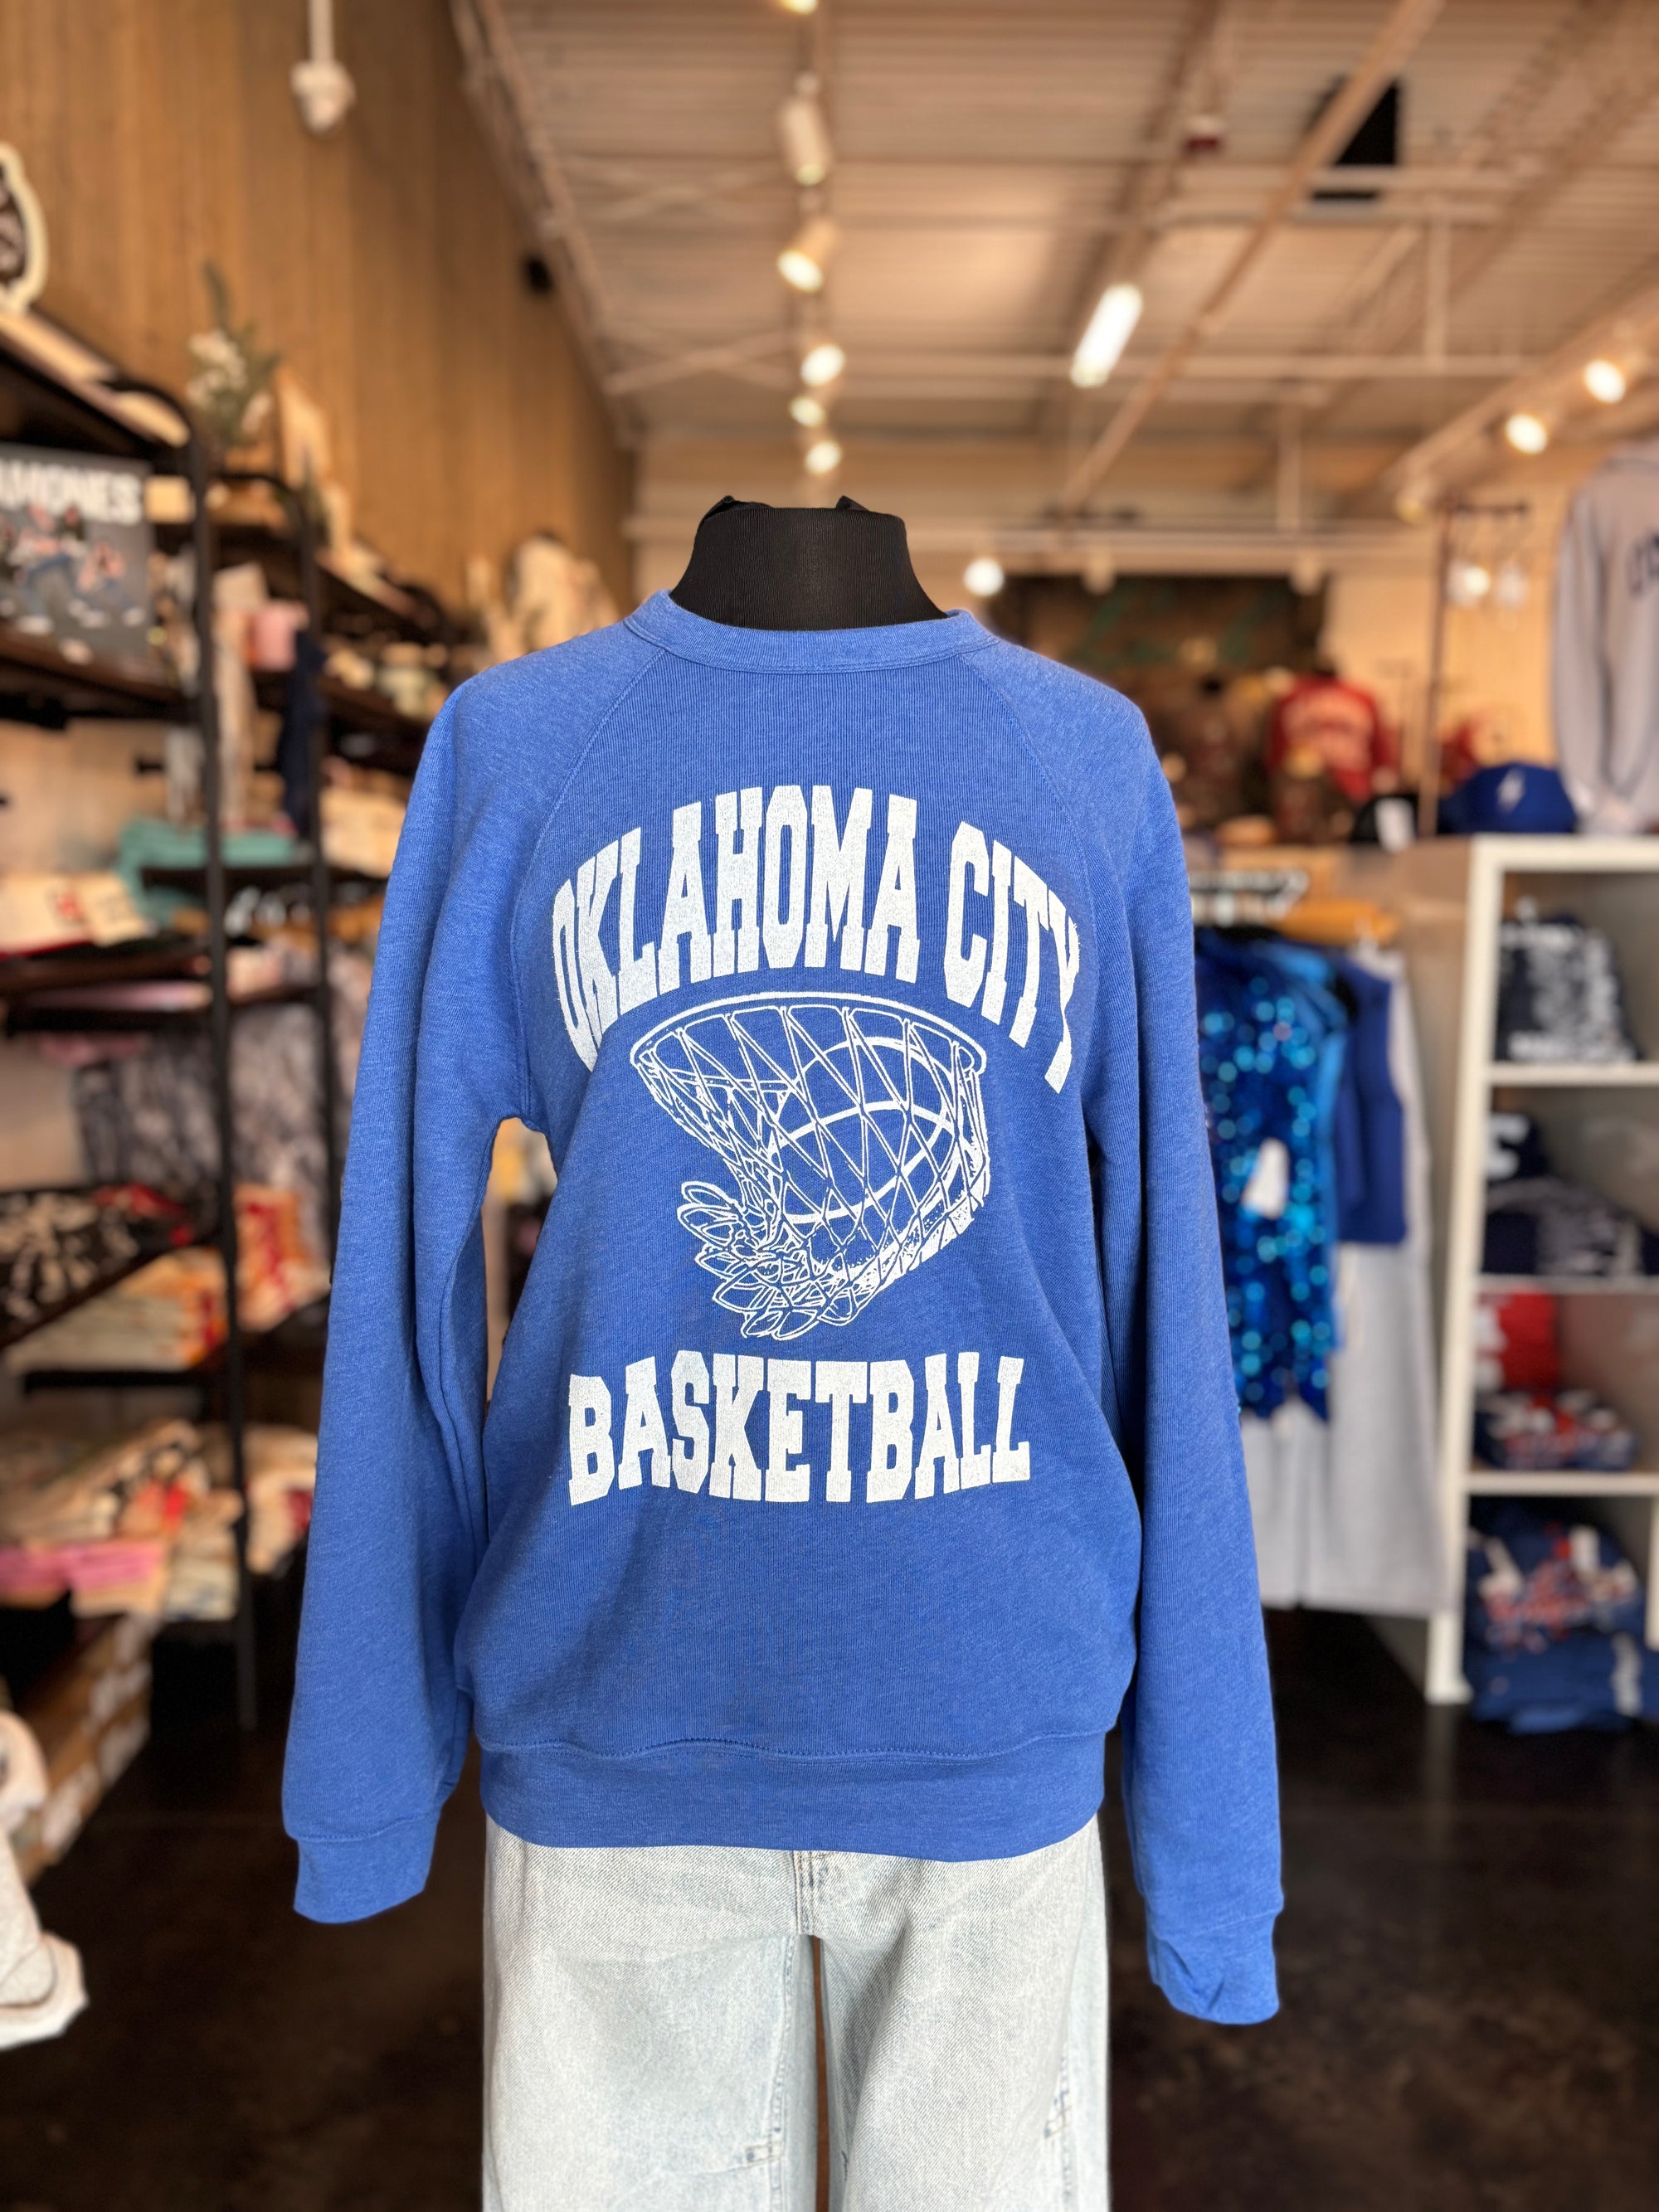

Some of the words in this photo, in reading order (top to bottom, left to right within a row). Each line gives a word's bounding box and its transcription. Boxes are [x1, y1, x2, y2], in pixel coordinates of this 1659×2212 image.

[552, 785, 920, 1072] OKLAHOMA
[943, 821, 1081, 1093] CITY
[568, 1350, 1029, 1505] BASKETBALL
